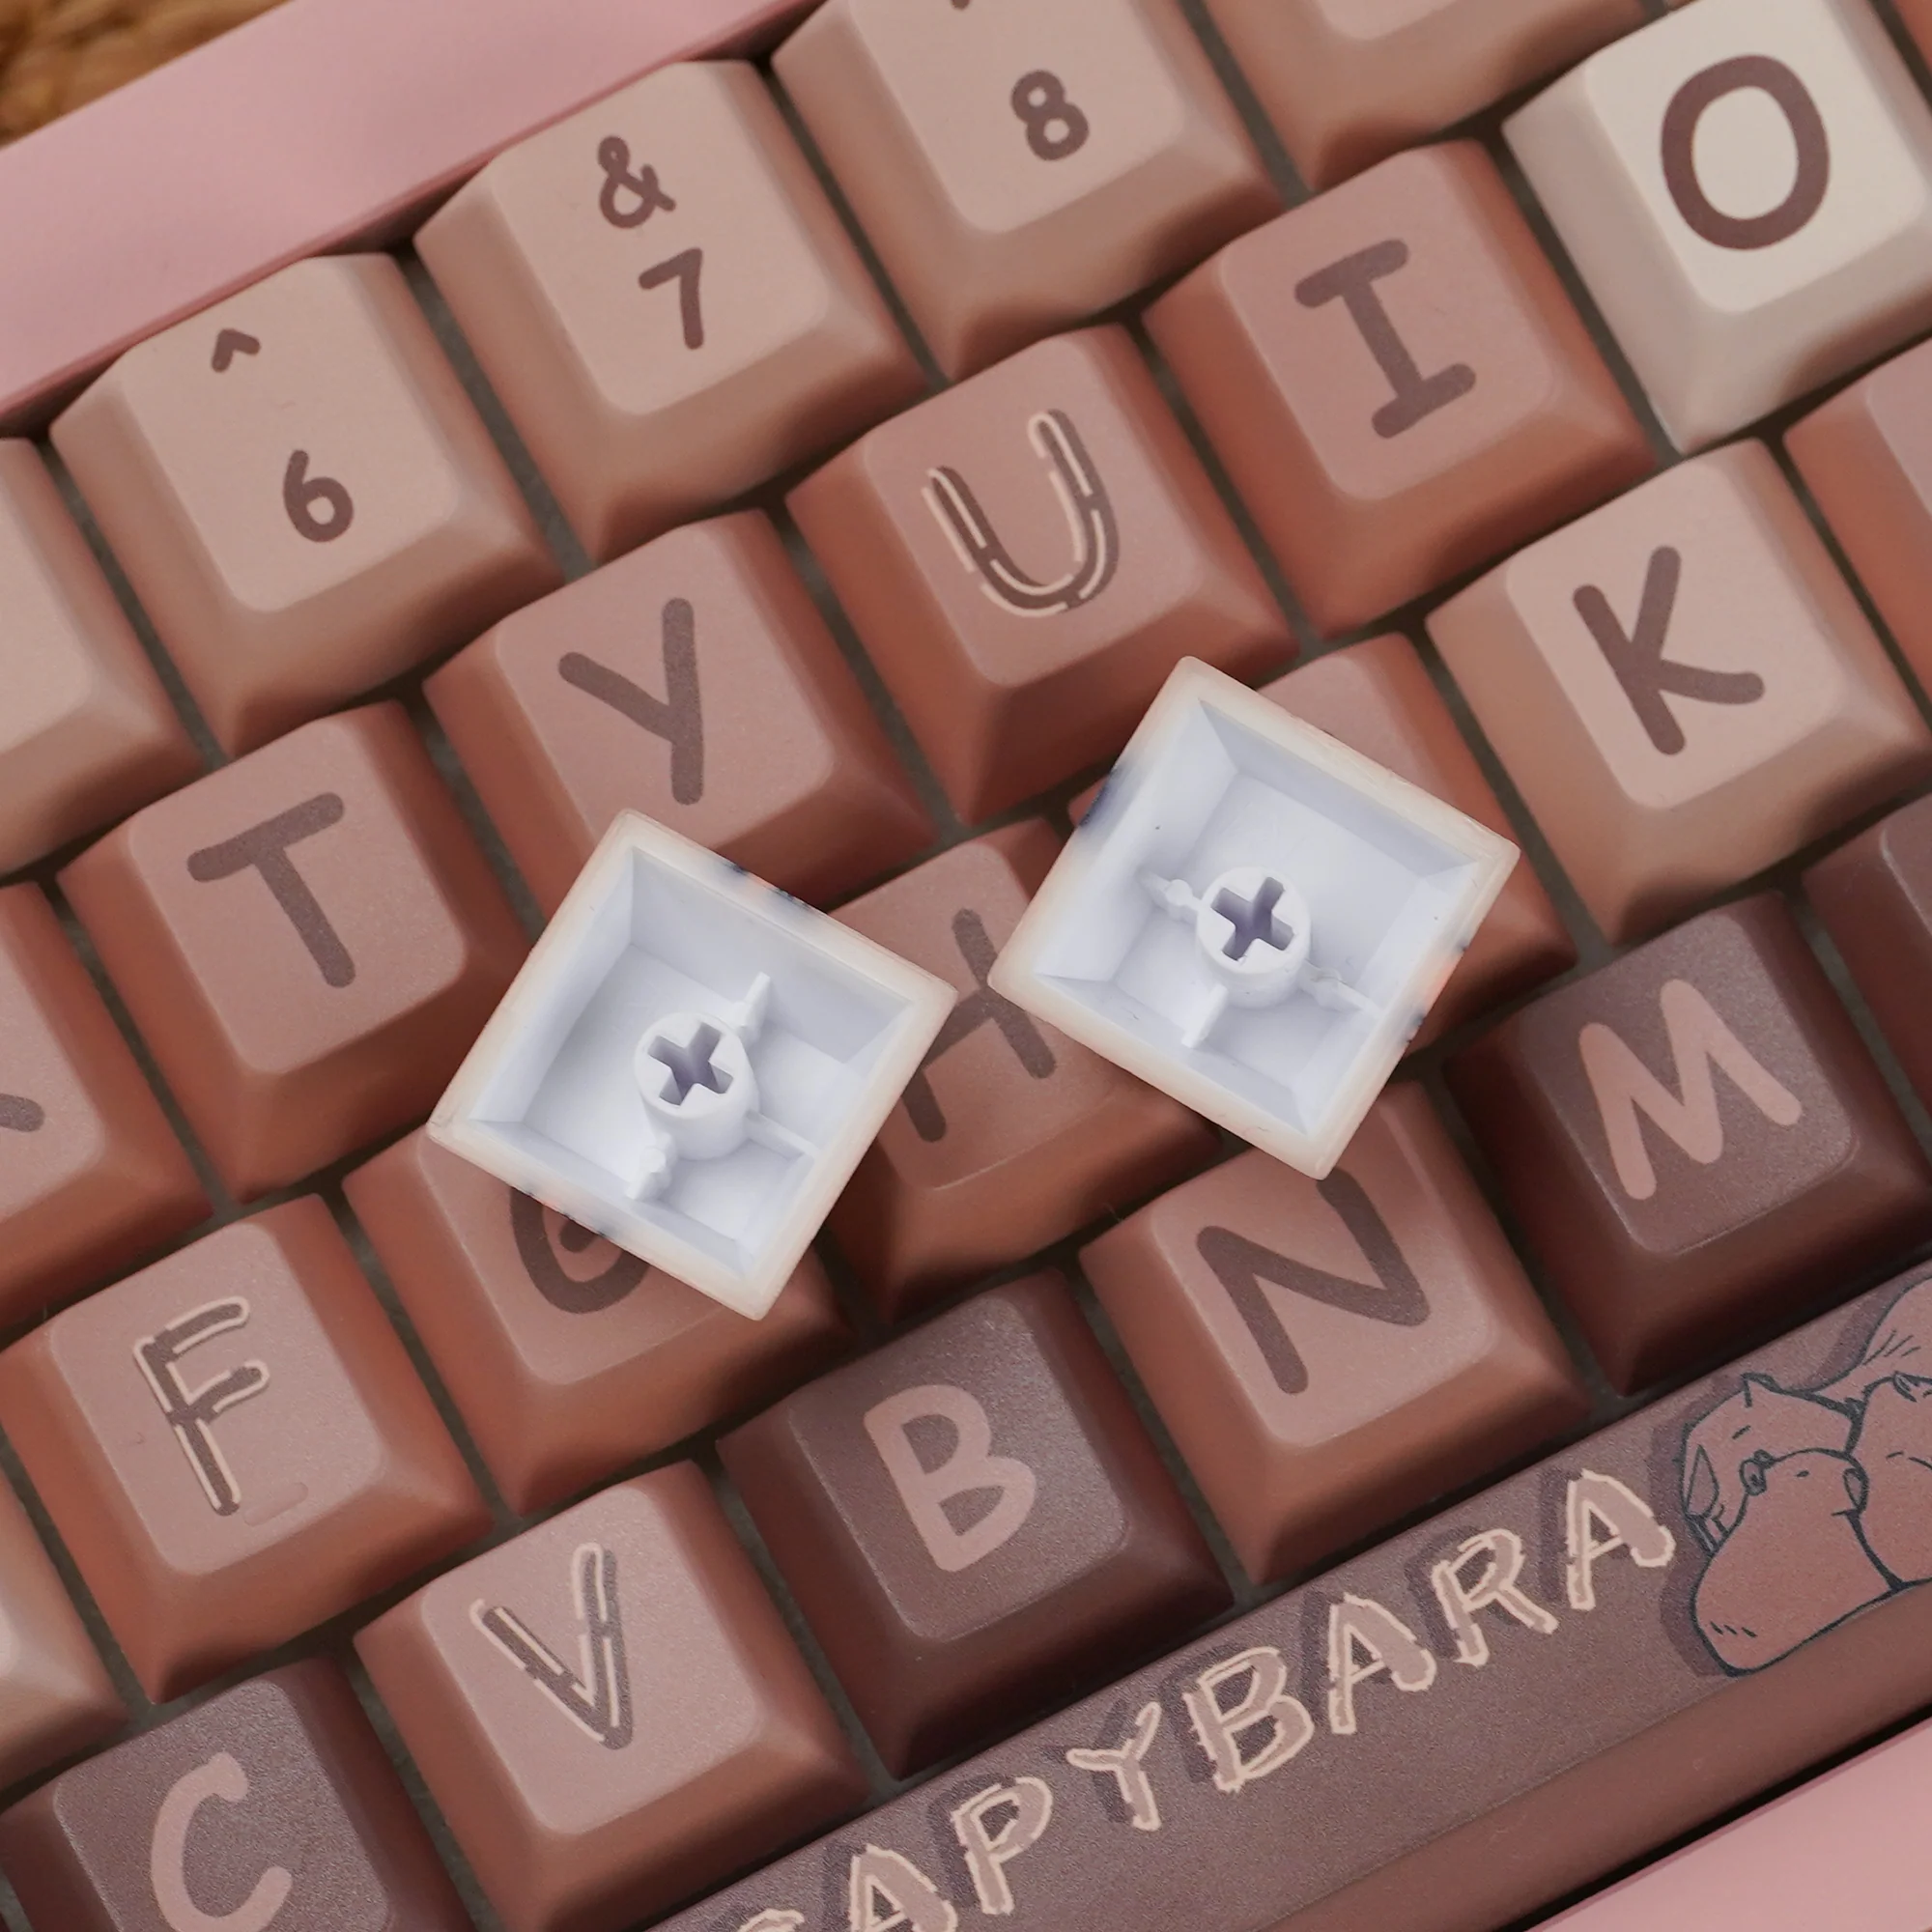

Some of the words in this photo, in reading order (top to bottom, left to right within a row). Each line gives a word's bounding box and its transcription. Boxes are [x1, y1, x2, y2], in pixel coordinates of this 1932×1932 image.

[598, 135, 676, 229] &
[1010, 70, 1090, 161] 8
[1661, 54, 1831, 251] O
[639, 247, 704, 350] 7
[1294, 239, 1477, 440] I
[283, 449, 355, 543] 6
[921, 408, 1121, 617] U
[558, 596, 705, 805] Y
[1572, 545, 1765, 756] K
[186, 791, 356, 988] T
[1578, 979, 1803, 1201] M
[1196, 1166, 1431, 1397] N
[133, 1295, 270, 1517] F
[863, 1383, 1037, 1573] B
[469, 1543, 634, 1750] V
[737, 1467, 1677, 1932] APYBARA
[150, 1750, 292, 1932] C
